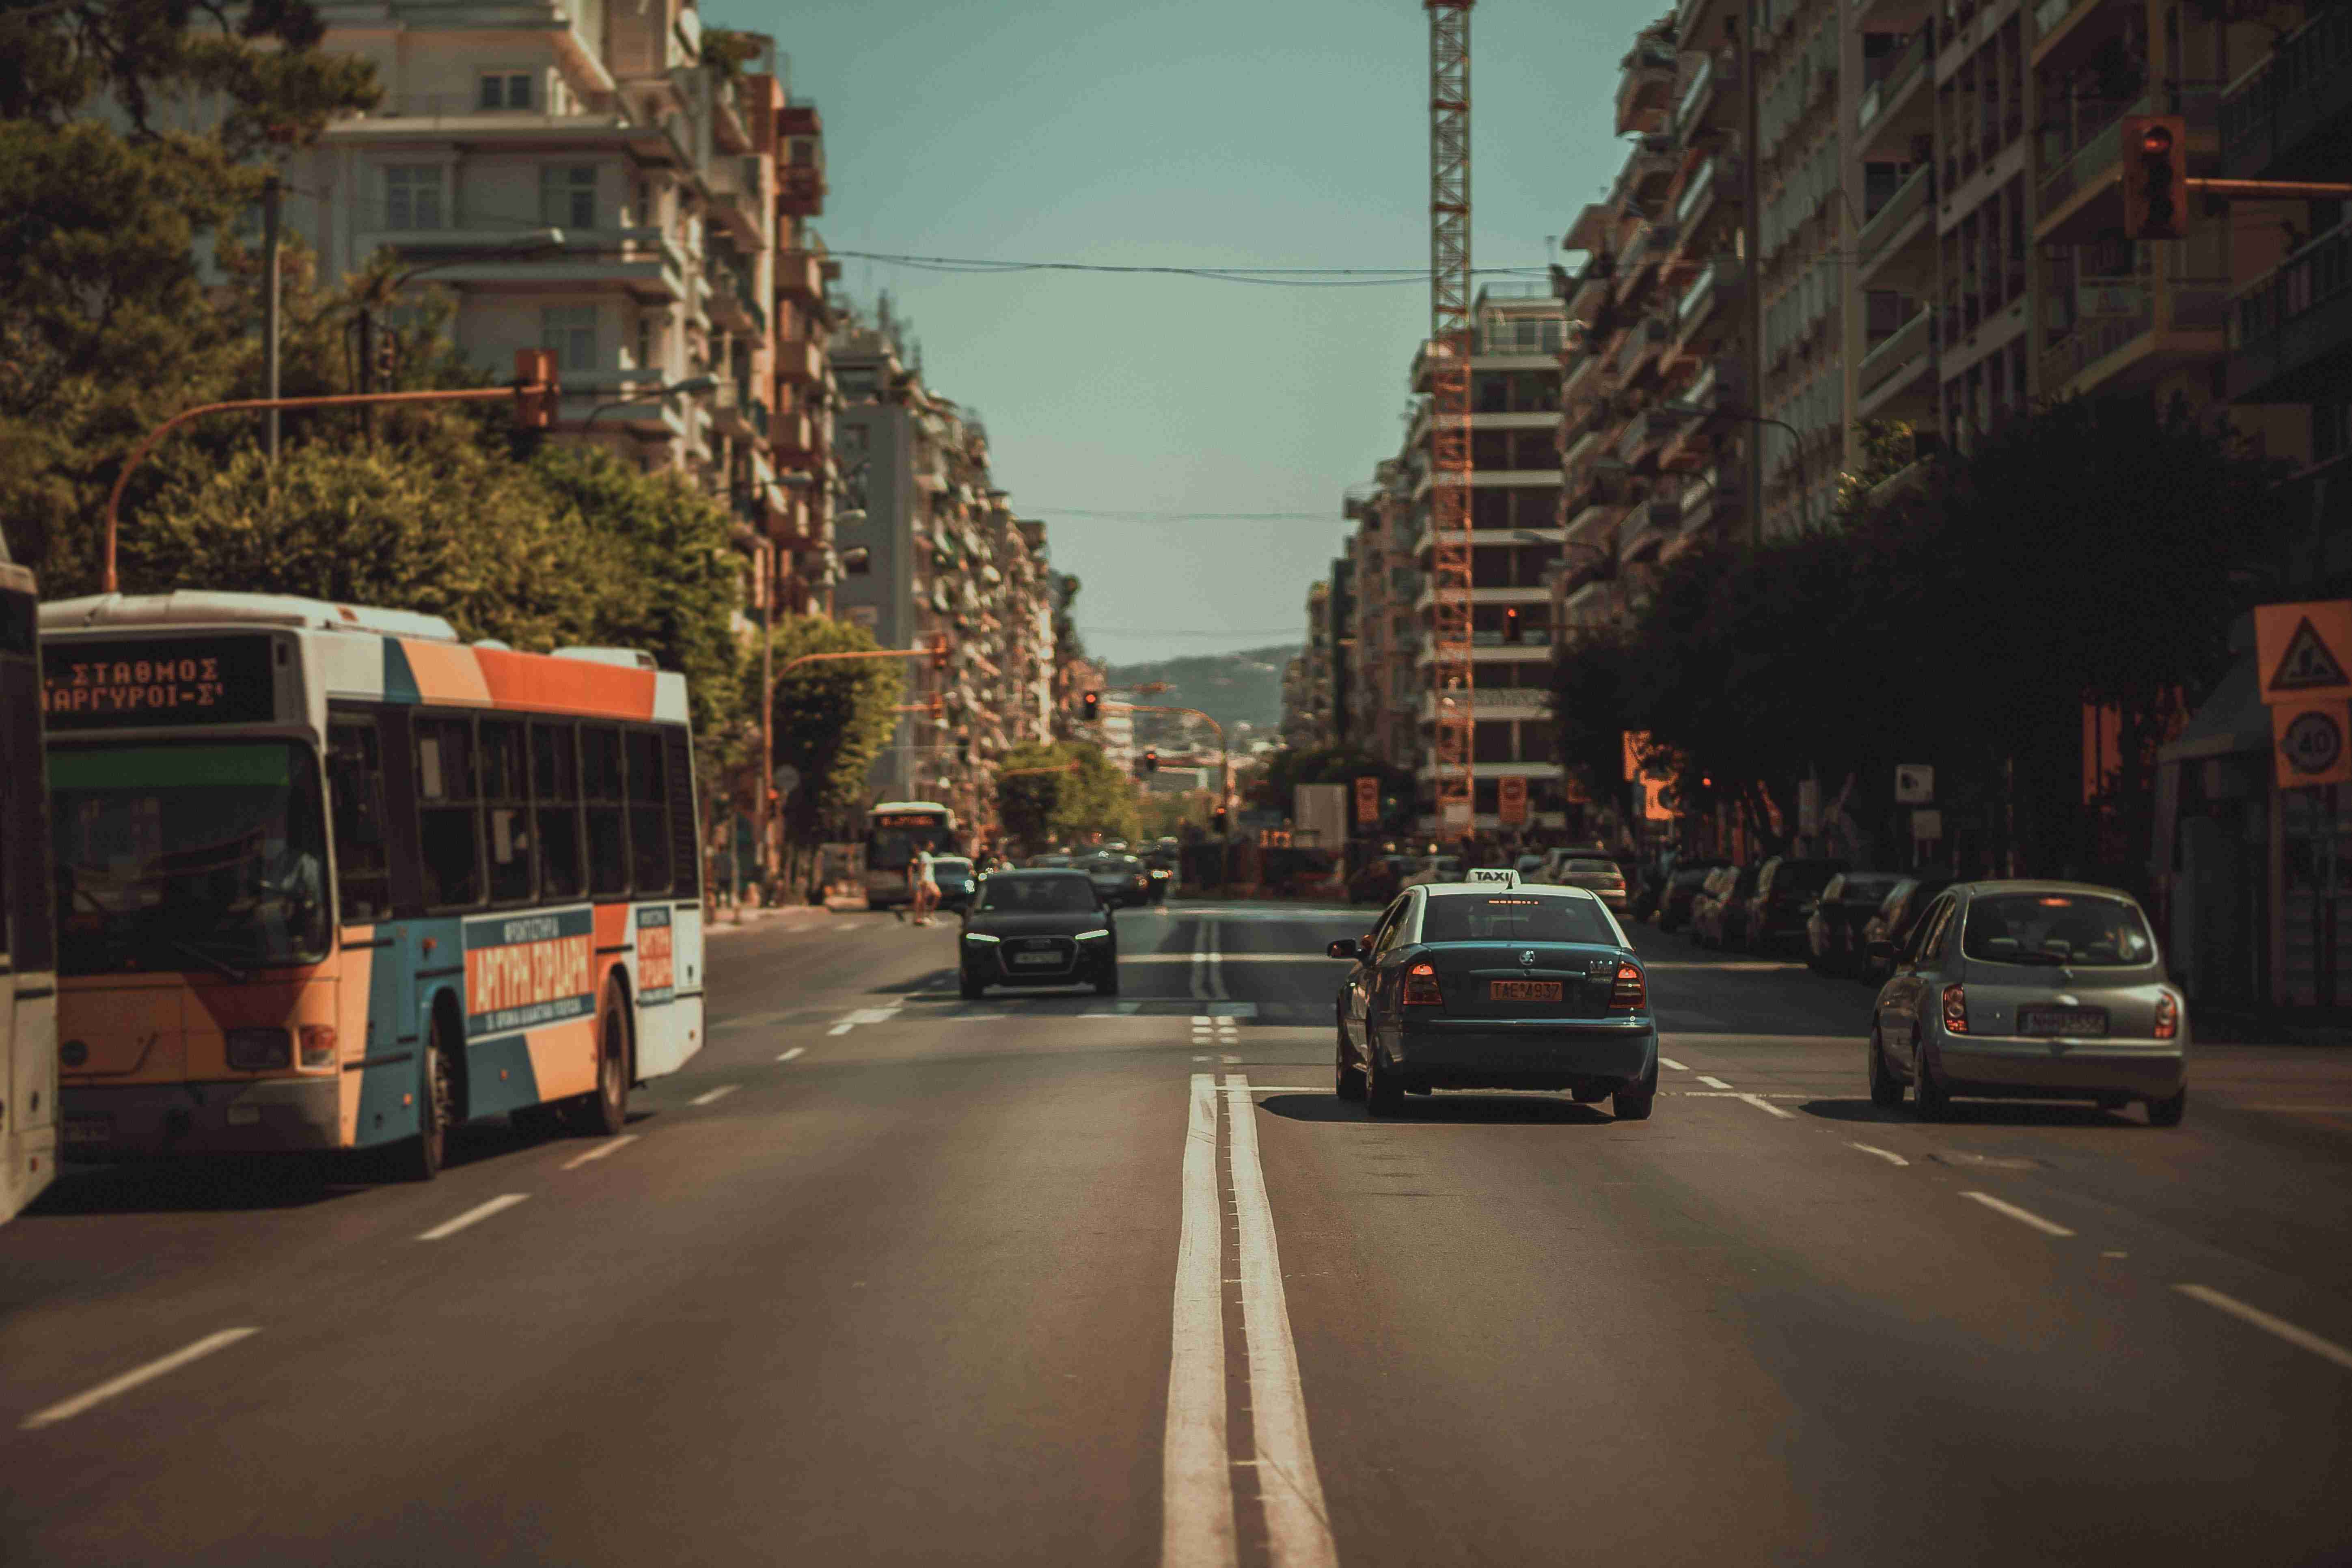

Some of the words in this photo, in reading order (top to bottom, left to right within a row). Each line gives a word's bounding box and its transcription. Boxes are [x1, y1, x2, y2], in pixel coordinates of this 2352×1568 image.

[71, 657, 218, 685] ΣΤΑΘΜΟΣ
[2299, 729, 2328, 753] 40
[1474, 871, 1509, 881] TAXI
